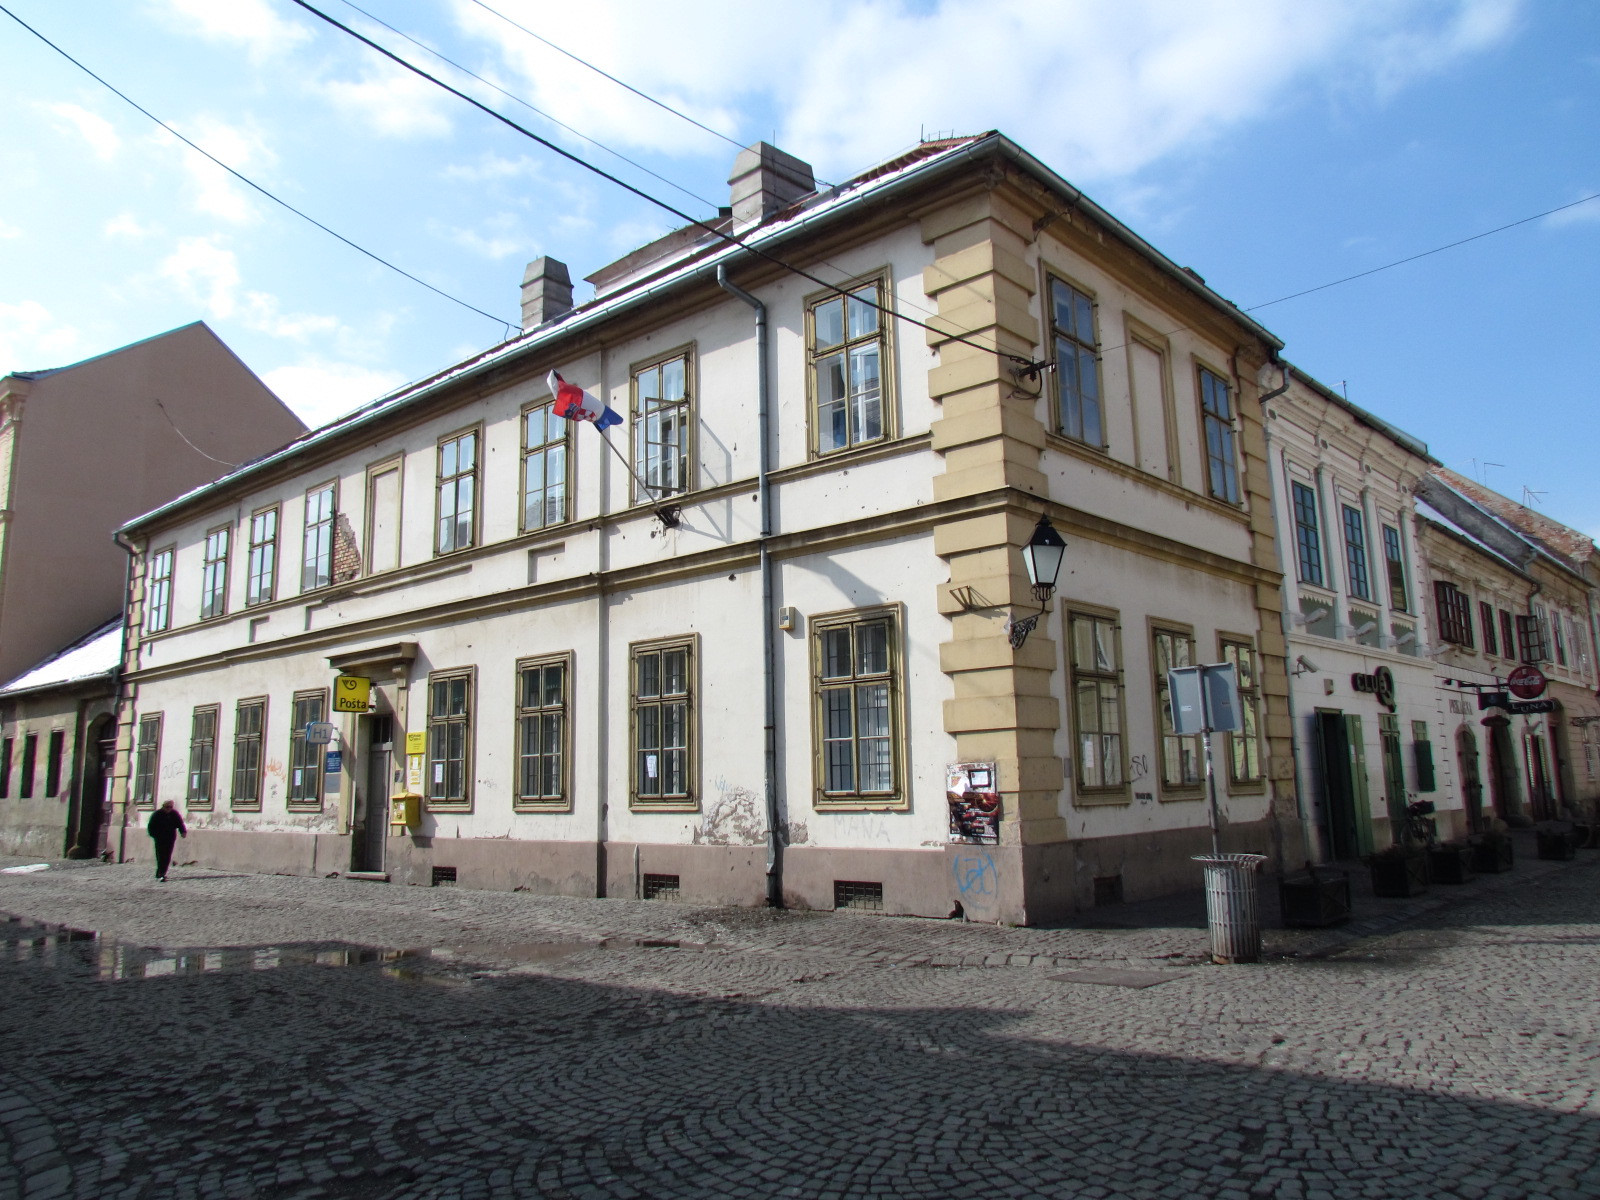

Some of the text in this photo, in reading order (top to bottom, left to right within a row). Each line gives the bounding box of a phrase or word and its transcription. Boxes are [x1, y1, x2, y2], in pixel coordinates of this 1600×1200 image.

[1510, 675, 1541, 686] Coca-Cola
[1355, 666, 1397, 713] CLUB Q
[339, 697, 367, 709] Pošta
[1511, 701, 1549, 713] LUNA
[313, 727, 329, 739] H1
